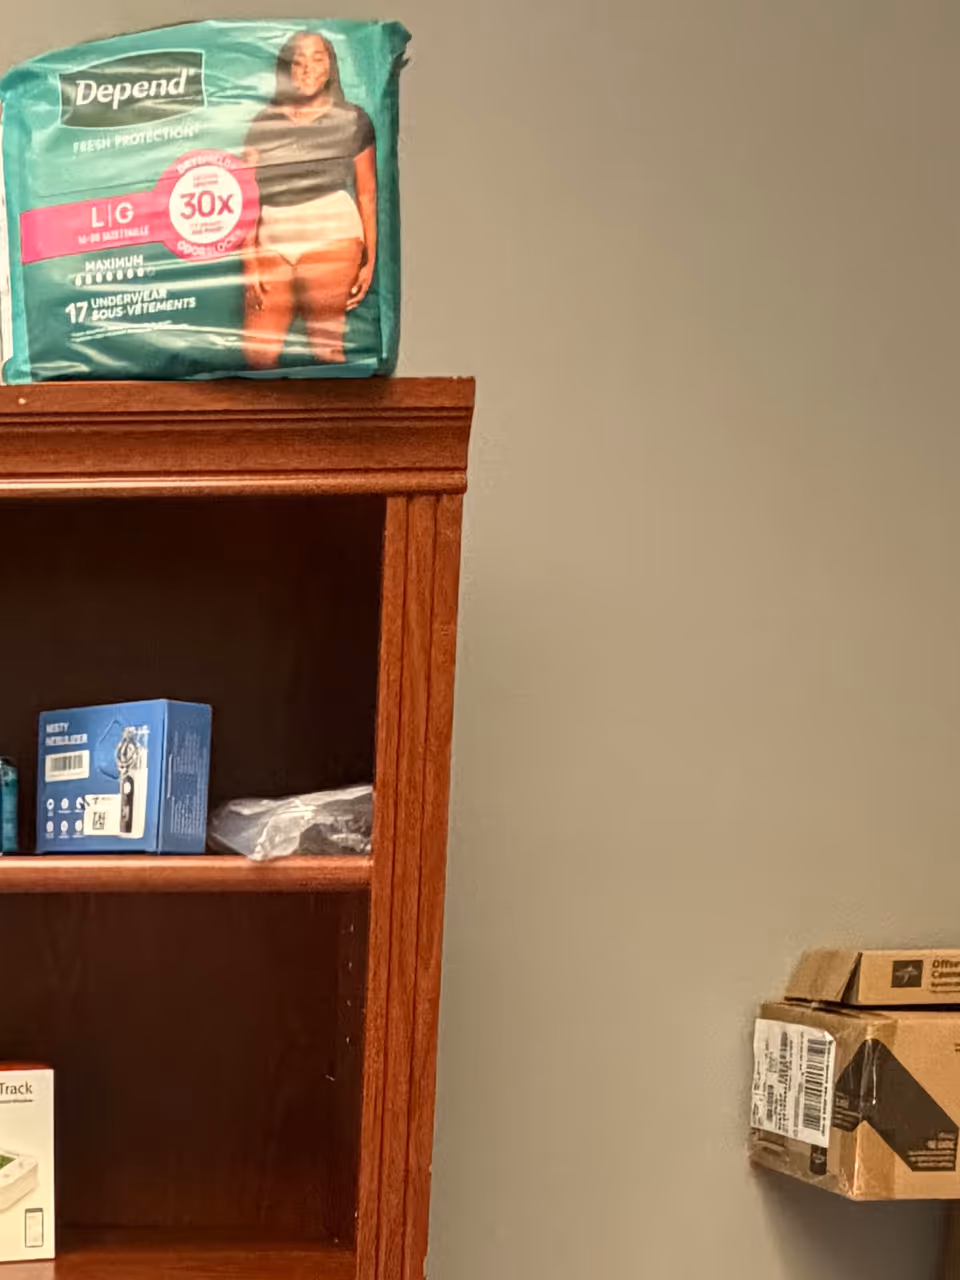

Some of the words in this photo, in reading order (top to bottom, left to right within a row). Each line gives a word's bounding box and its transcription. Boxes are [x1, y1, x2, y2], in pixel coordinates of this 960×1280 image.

[76, 68, 187, 110] Depend
[73, 138, 111, 153] FRESH
[180, 190, 234, 219] 30x
[85, 254, 144, 272] MAXIMUM
[65, 301, 88, 323] 17
[91, 289, 167, 308] UNDERWEAR
